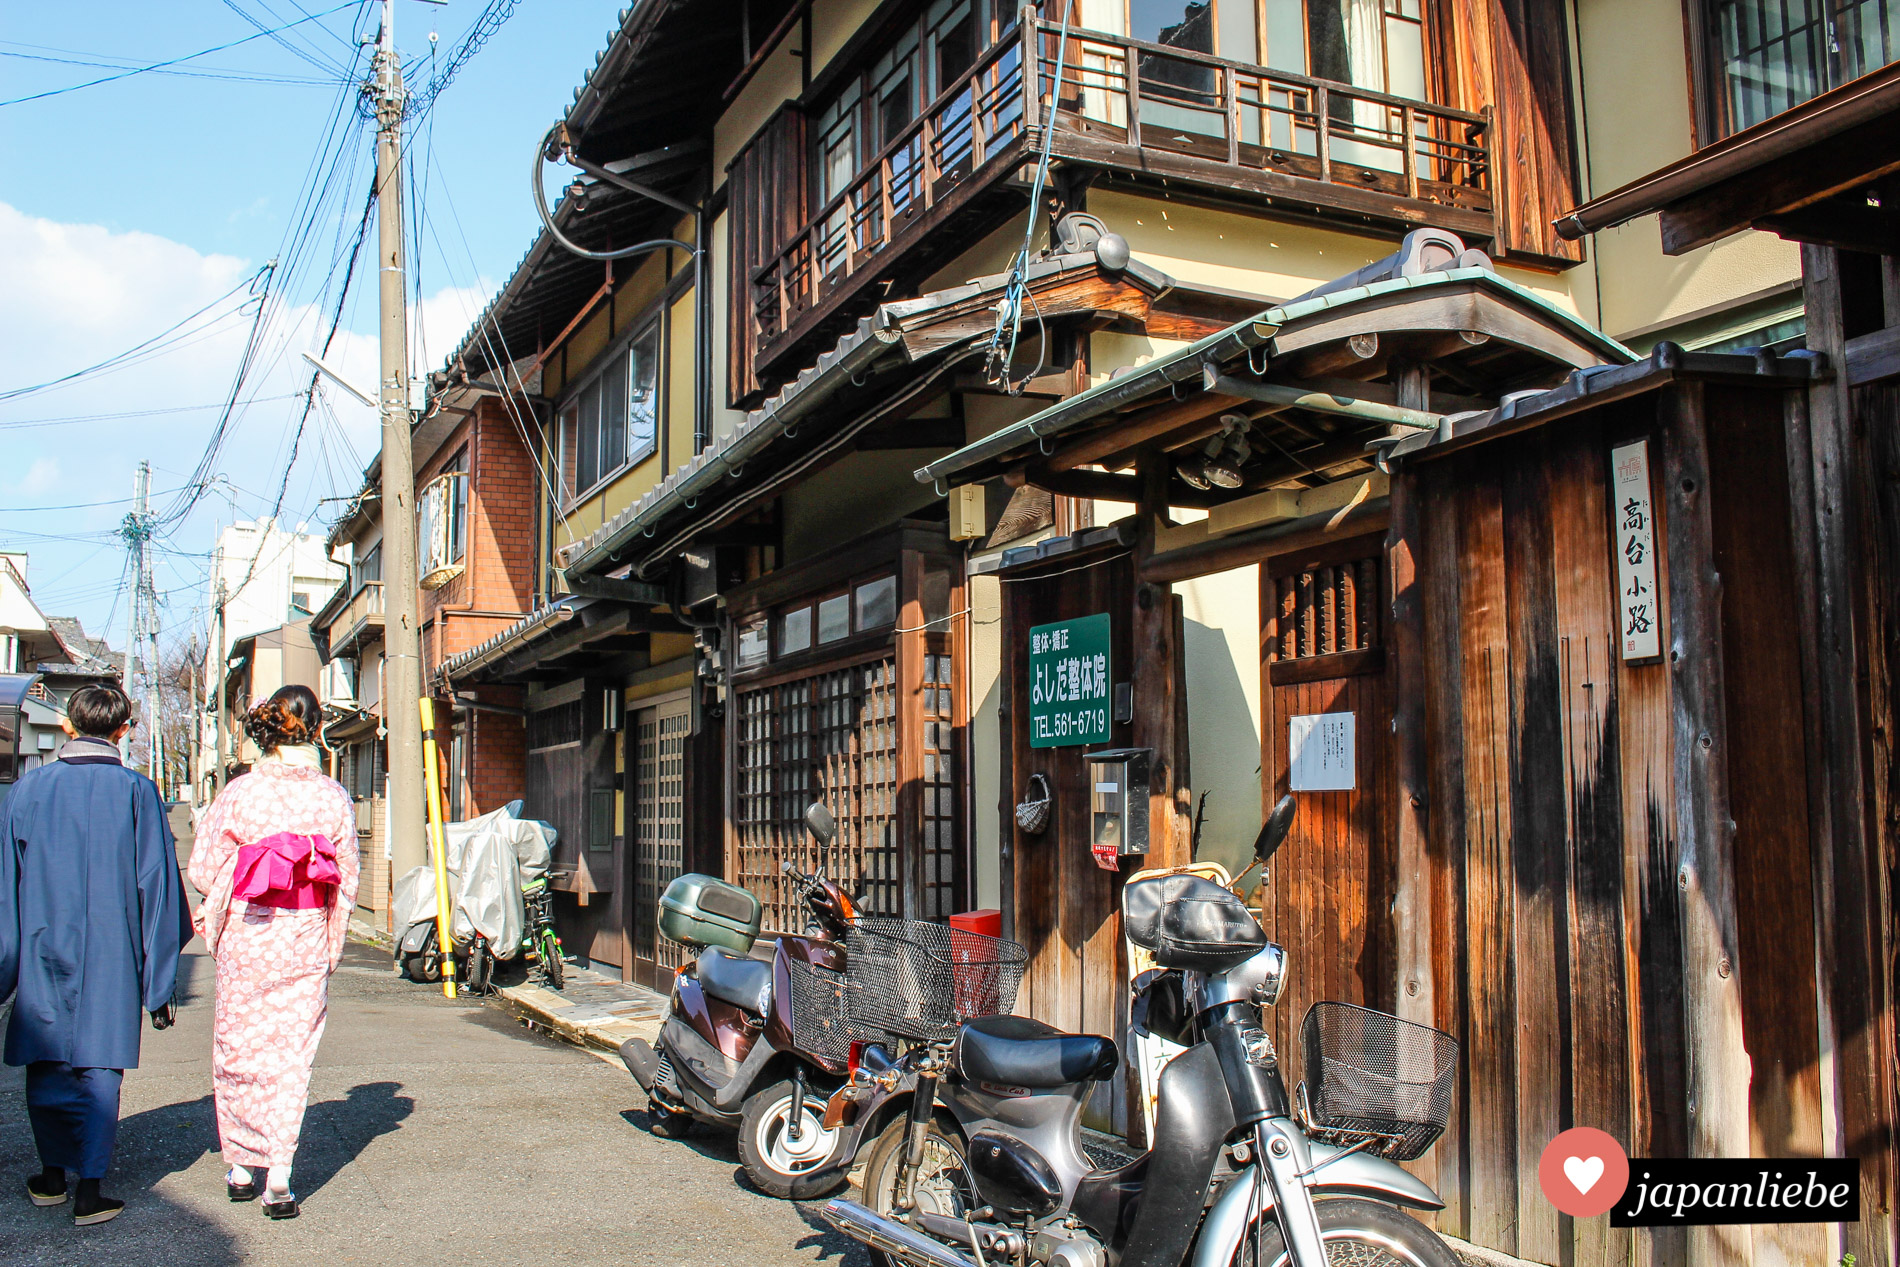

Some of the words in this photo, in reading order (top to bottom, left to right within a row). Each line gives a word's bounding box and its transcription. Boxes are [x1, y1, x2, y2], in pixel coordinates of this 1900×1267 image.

[1623, 497, 1652, 636] 高台小路
[1032, 652, 1106, 705] よしだ整体院
[1009, 1087, 1025, 1095] Cub
